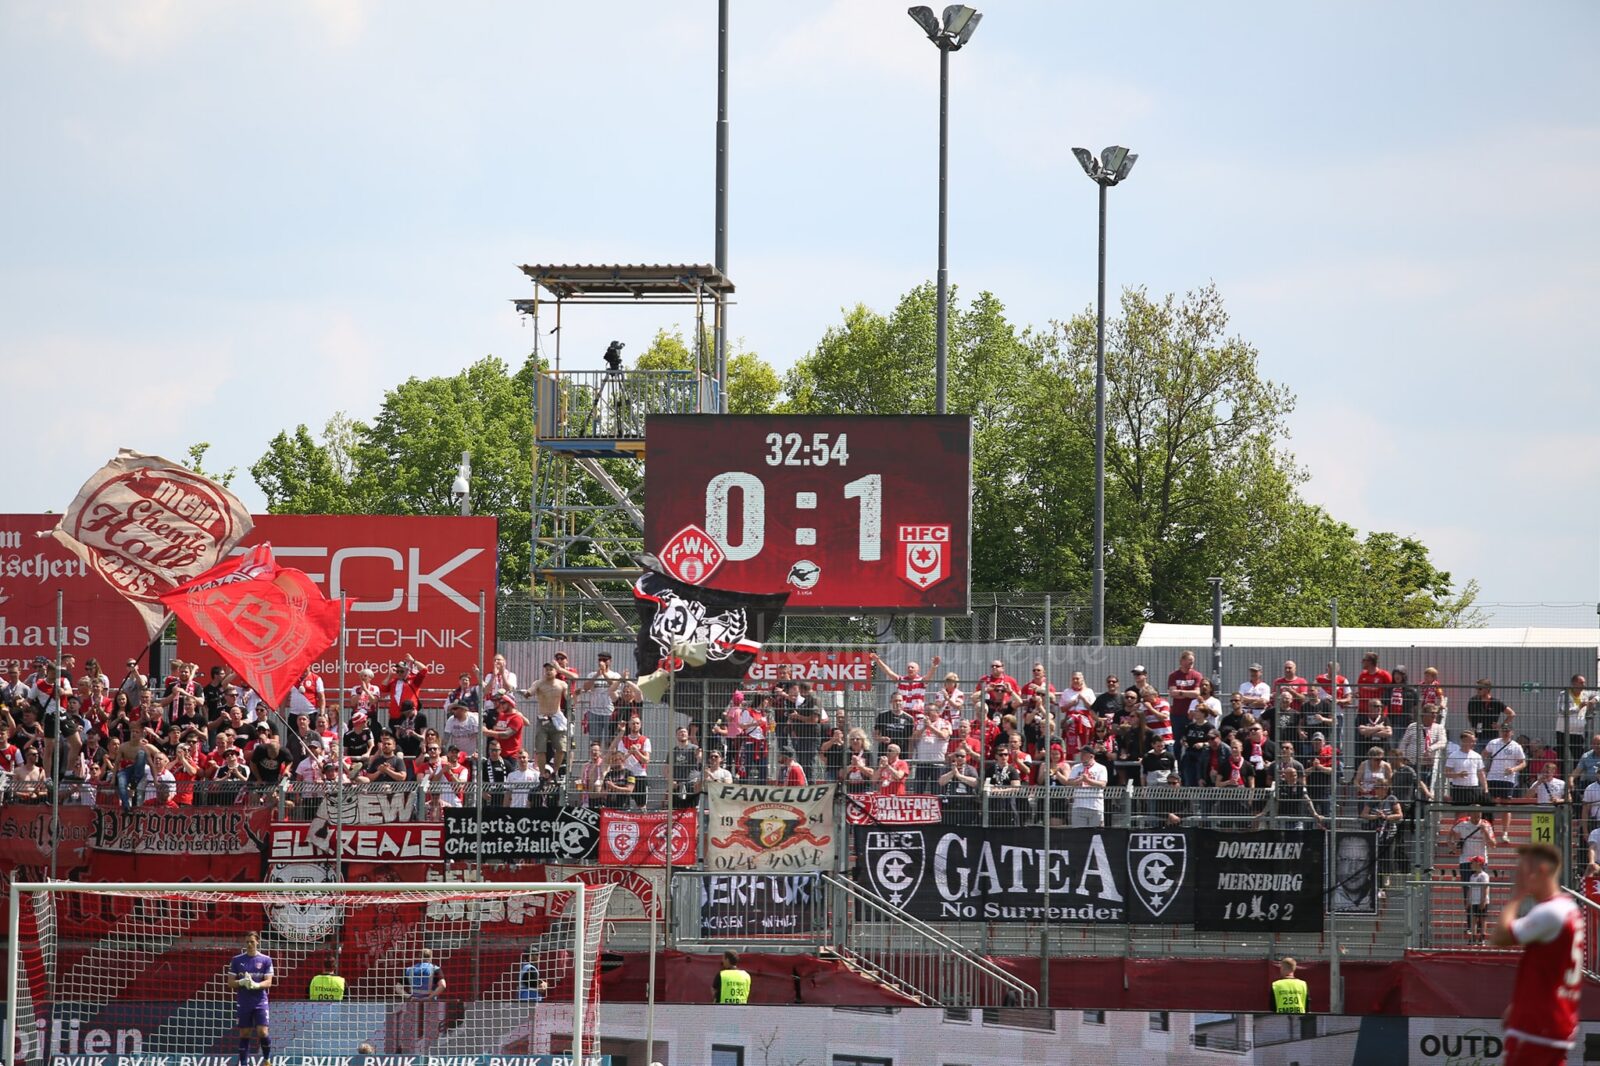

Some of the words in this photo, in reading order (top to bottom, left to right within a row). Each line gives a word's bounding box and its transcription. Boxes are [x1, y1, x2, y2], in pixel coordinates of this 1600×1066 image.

[766, 432, 849, 466] 32:54
[705, 471, 765, 561] 0
[844, 473, 882, 561] 1
[902, 527, 946, 541] HFC
[748, 660, 867, 680] GERÄNKE
[720, 786, 829, 803] FANCLUB
[446, 815, 516, 834] Libertà
[571, 806, 599, 825] HFC
[720, 816, 734, 827] 19
[809, 814, 824, 824] 84
[876, 833, 913, 848] HFC
[1138, 836, 1176, 849] HFC
[1535, 827, 1551, 842] 14
[445, 837, 514, 855] Chemie
[514, 836, 561, 854] Halle
[1216, 841, 1304, 860] DOMFALKEN
[715, 852, 757, 870] OLLE
[1217, 872, 1303, 891] MERSEBURG
[940, 902, 977, 918] No
[984, 903, 1123, 920] Surrender
[1420, 1034, 1504, 1059] OUTD
